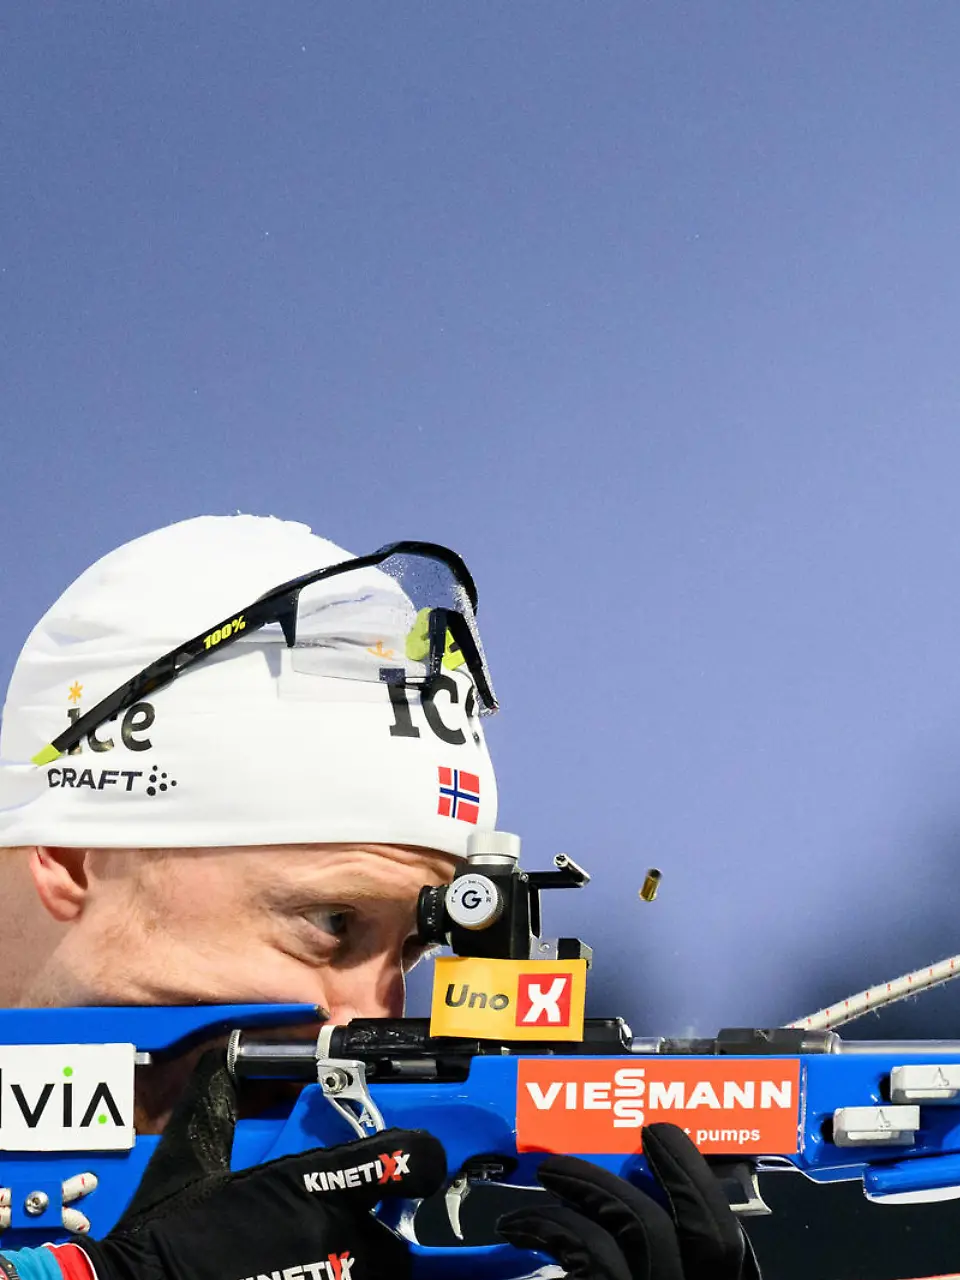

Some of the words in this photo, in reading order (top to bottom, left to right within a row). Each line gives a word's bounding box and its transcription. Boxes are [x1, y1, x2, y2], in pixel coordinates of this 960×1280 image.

[203, 615, 246, 650] 100%
[47, 767, 143, 791] CRAFT
[445, 983, 510, 1010] Uno
[525, 1068, 792, 1128] VIESSMANN
[696, 1129, 760, 1145] pumps
